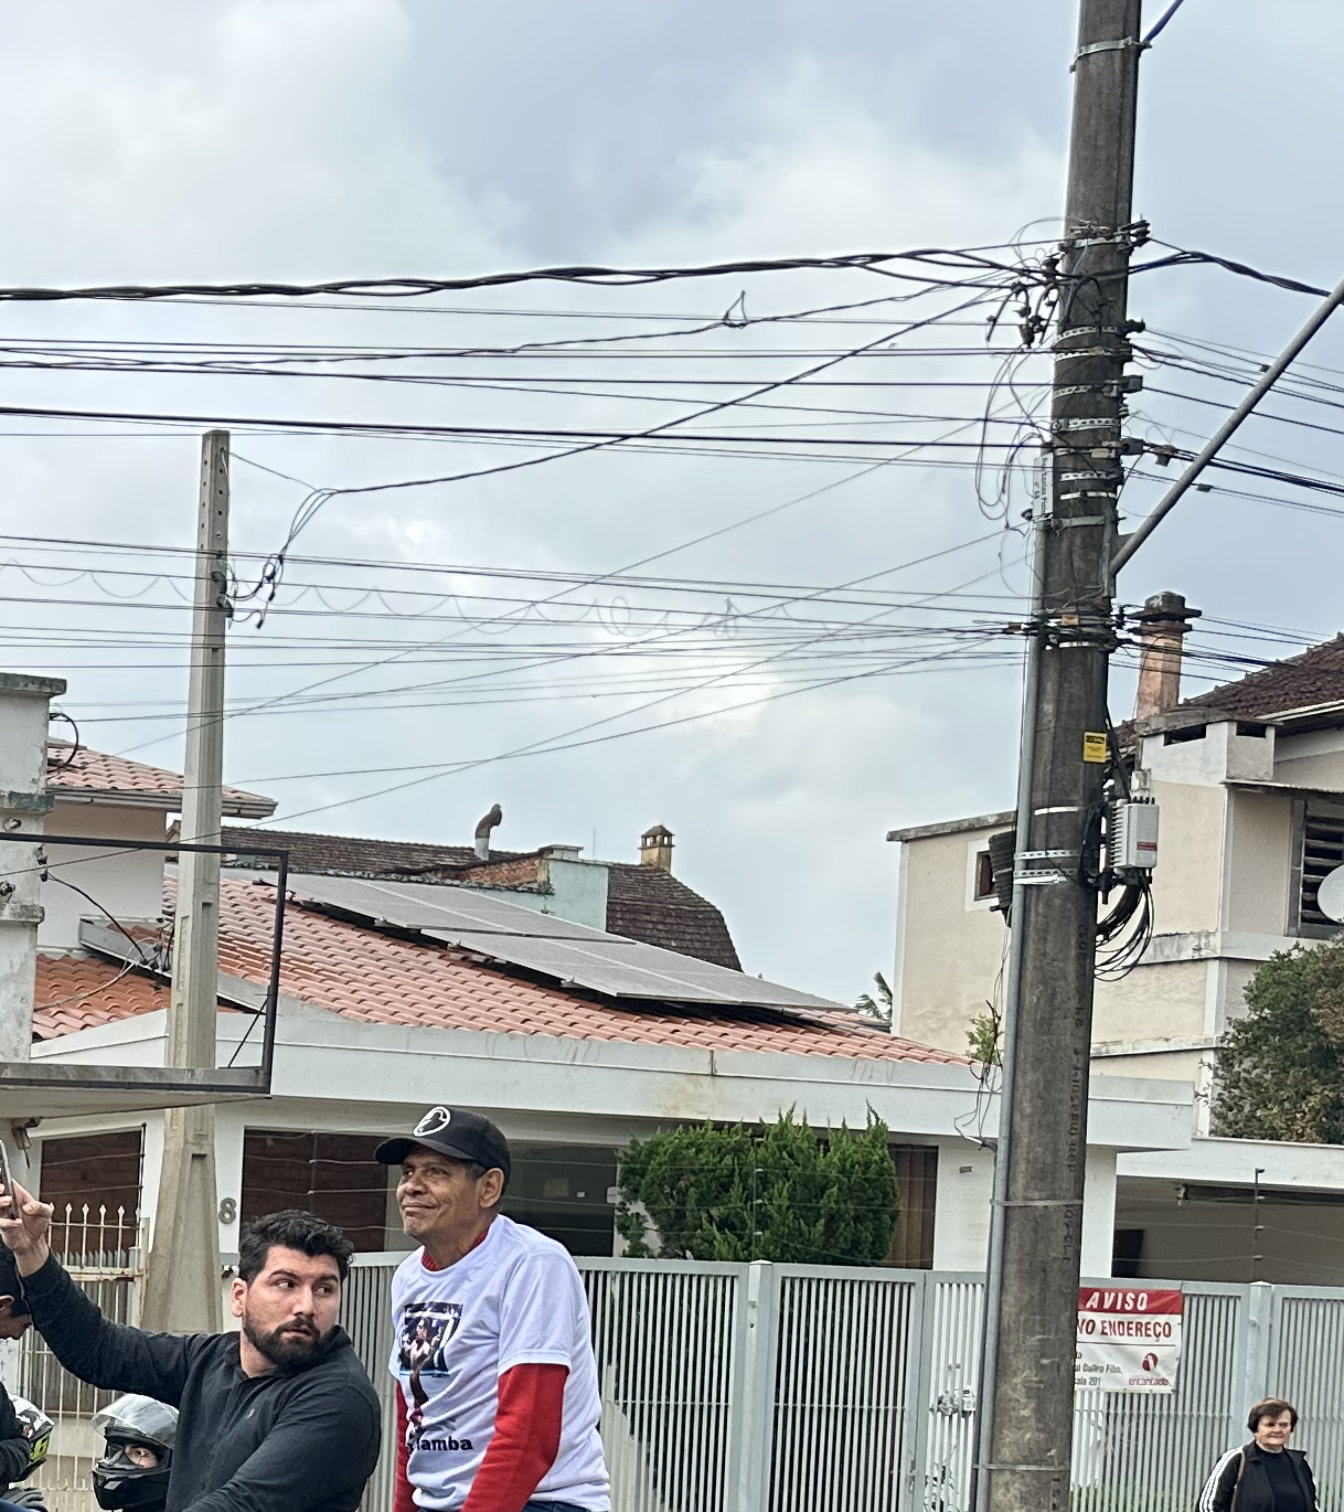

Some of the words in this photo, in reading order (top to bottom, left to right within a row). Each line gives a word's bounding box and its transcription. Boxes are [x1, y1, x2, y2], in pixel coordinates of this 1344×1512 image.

[218, 1197, 237, 1225] 8
[1086, 1292, 1149, 1311] AVISO
[1077, 1319, 1096, 1336] VO
[1100, 1319, 1172, 1342] ENDEREÇO
